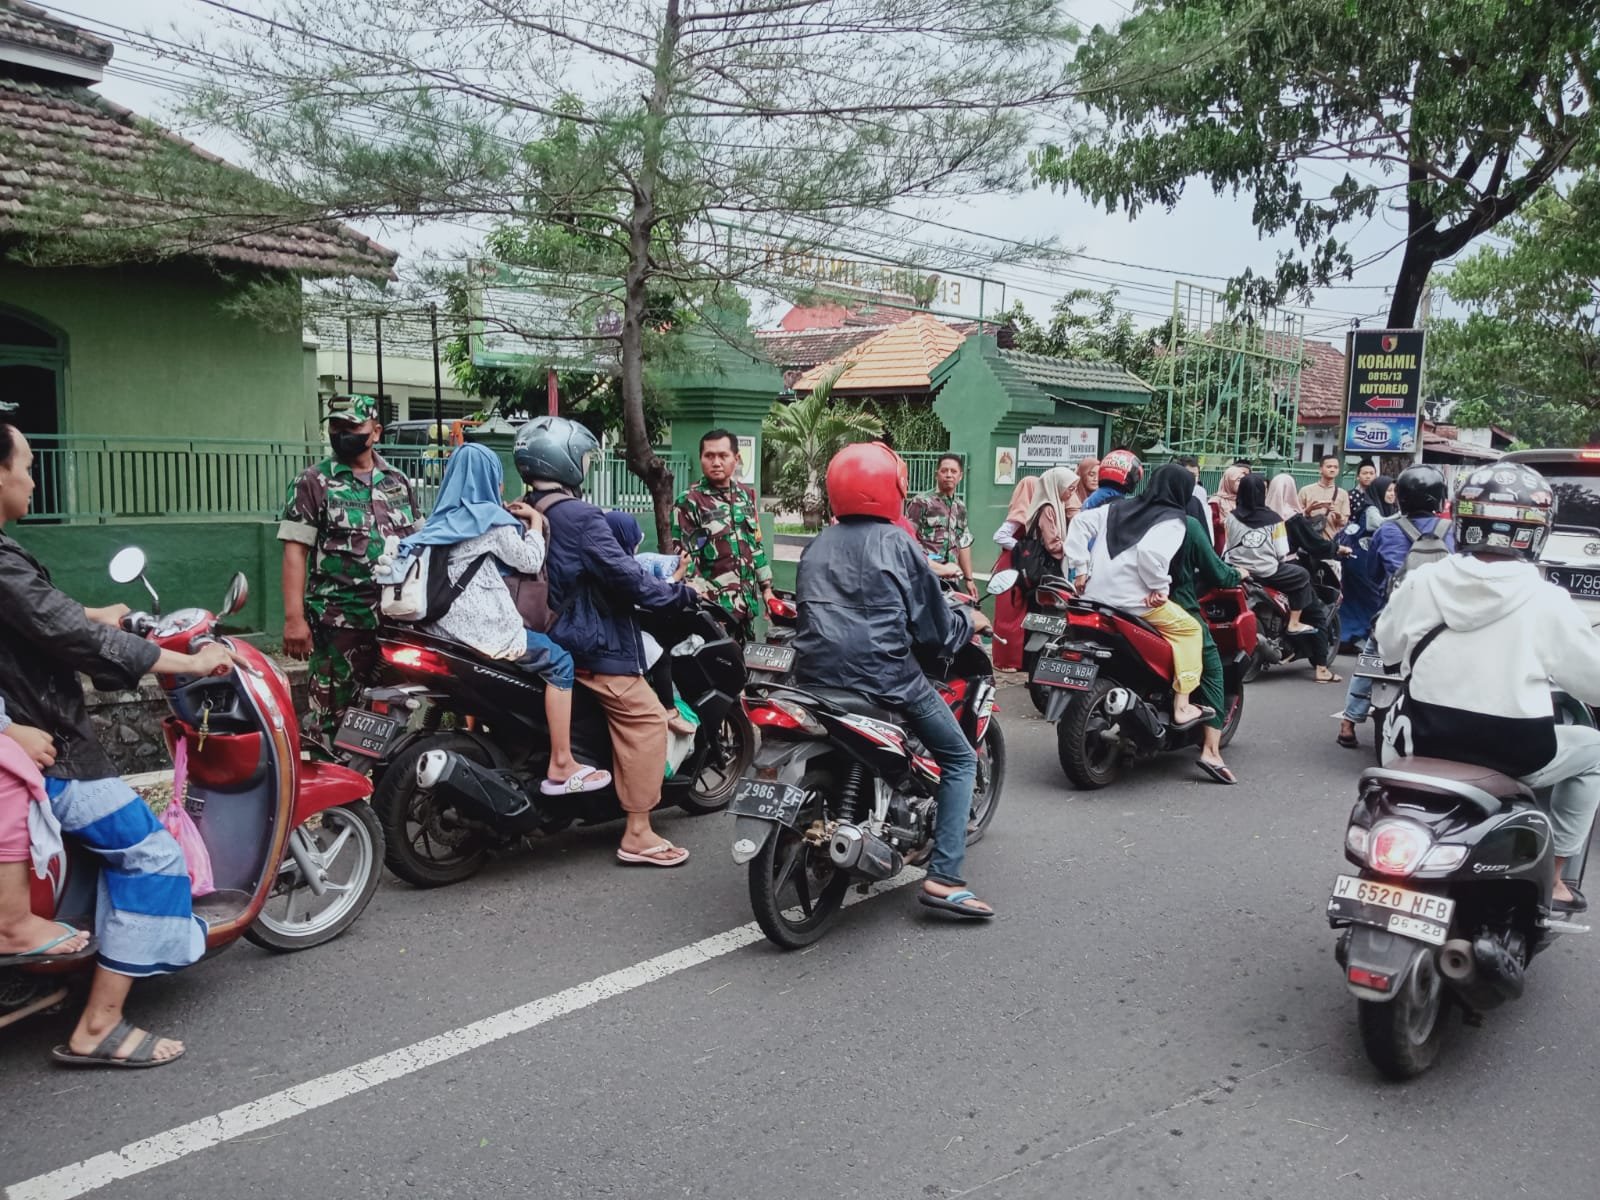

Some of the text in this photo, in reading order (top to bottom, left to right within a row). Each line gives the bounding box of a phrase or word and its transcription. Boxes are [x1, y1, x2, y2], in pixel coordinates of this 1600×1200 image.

[1357, 354, 1417, 369] KORAMIL
[1368, 371, 1402, 381] 0815/13
[1359, 383, 1408, 394] KUTOREJO
[1353, 425, 1388, 440] Sam
[1550, 572, 1560, 585] S
[1040, 662, 1047, 670] S
[345, 713, 353, 726] S
[744, 782, 776, 799] 2986
[1357, 883, 1402, 907] 6520
[1413, 895, 1447, 919] NFB
